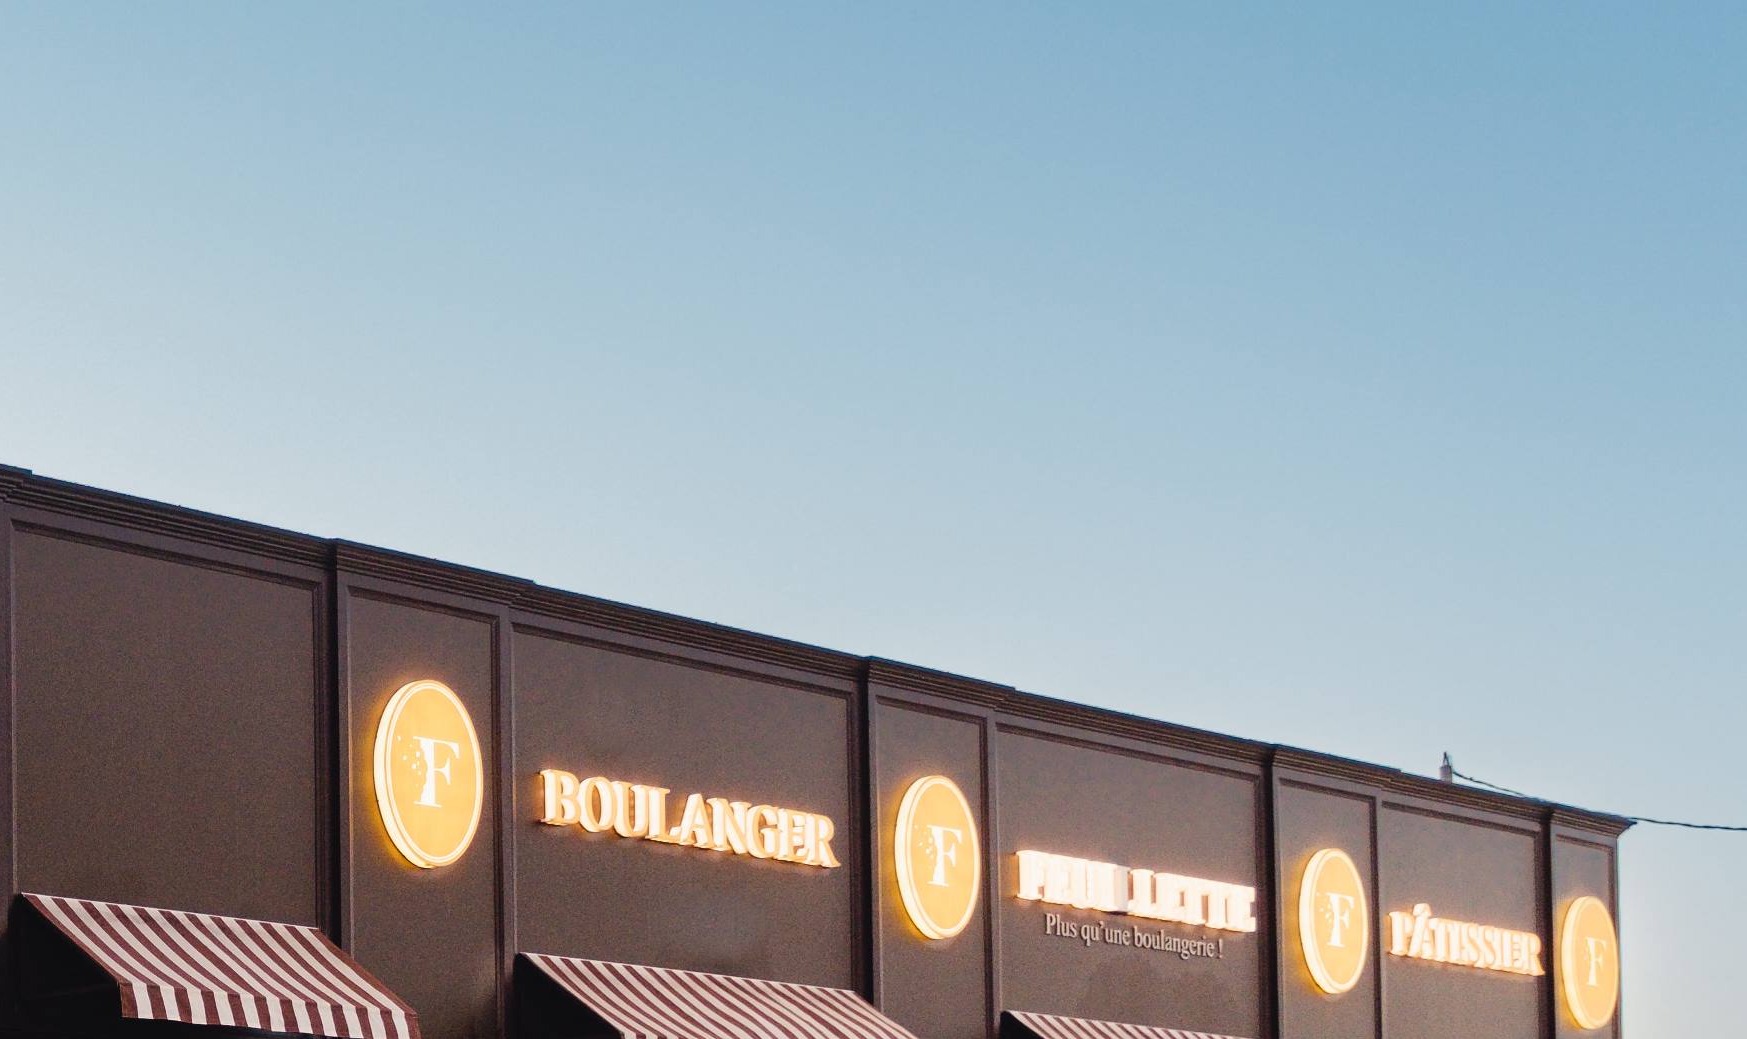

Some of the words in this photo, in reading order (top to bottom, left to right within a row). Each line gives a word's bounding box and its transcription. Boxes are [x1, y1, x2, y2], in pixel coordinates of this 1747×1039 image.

[412, 735, 460, 808] F
[537, 768, 841, 868] BOULANGER
[926, 824, 962, 887] F
[1045, 912, 1078, 938] Plus
[1132, 925, 1216, 960] boulangerie
[1324, 891, 1355, 949] F
[1584, 935, 1607, 987] F
